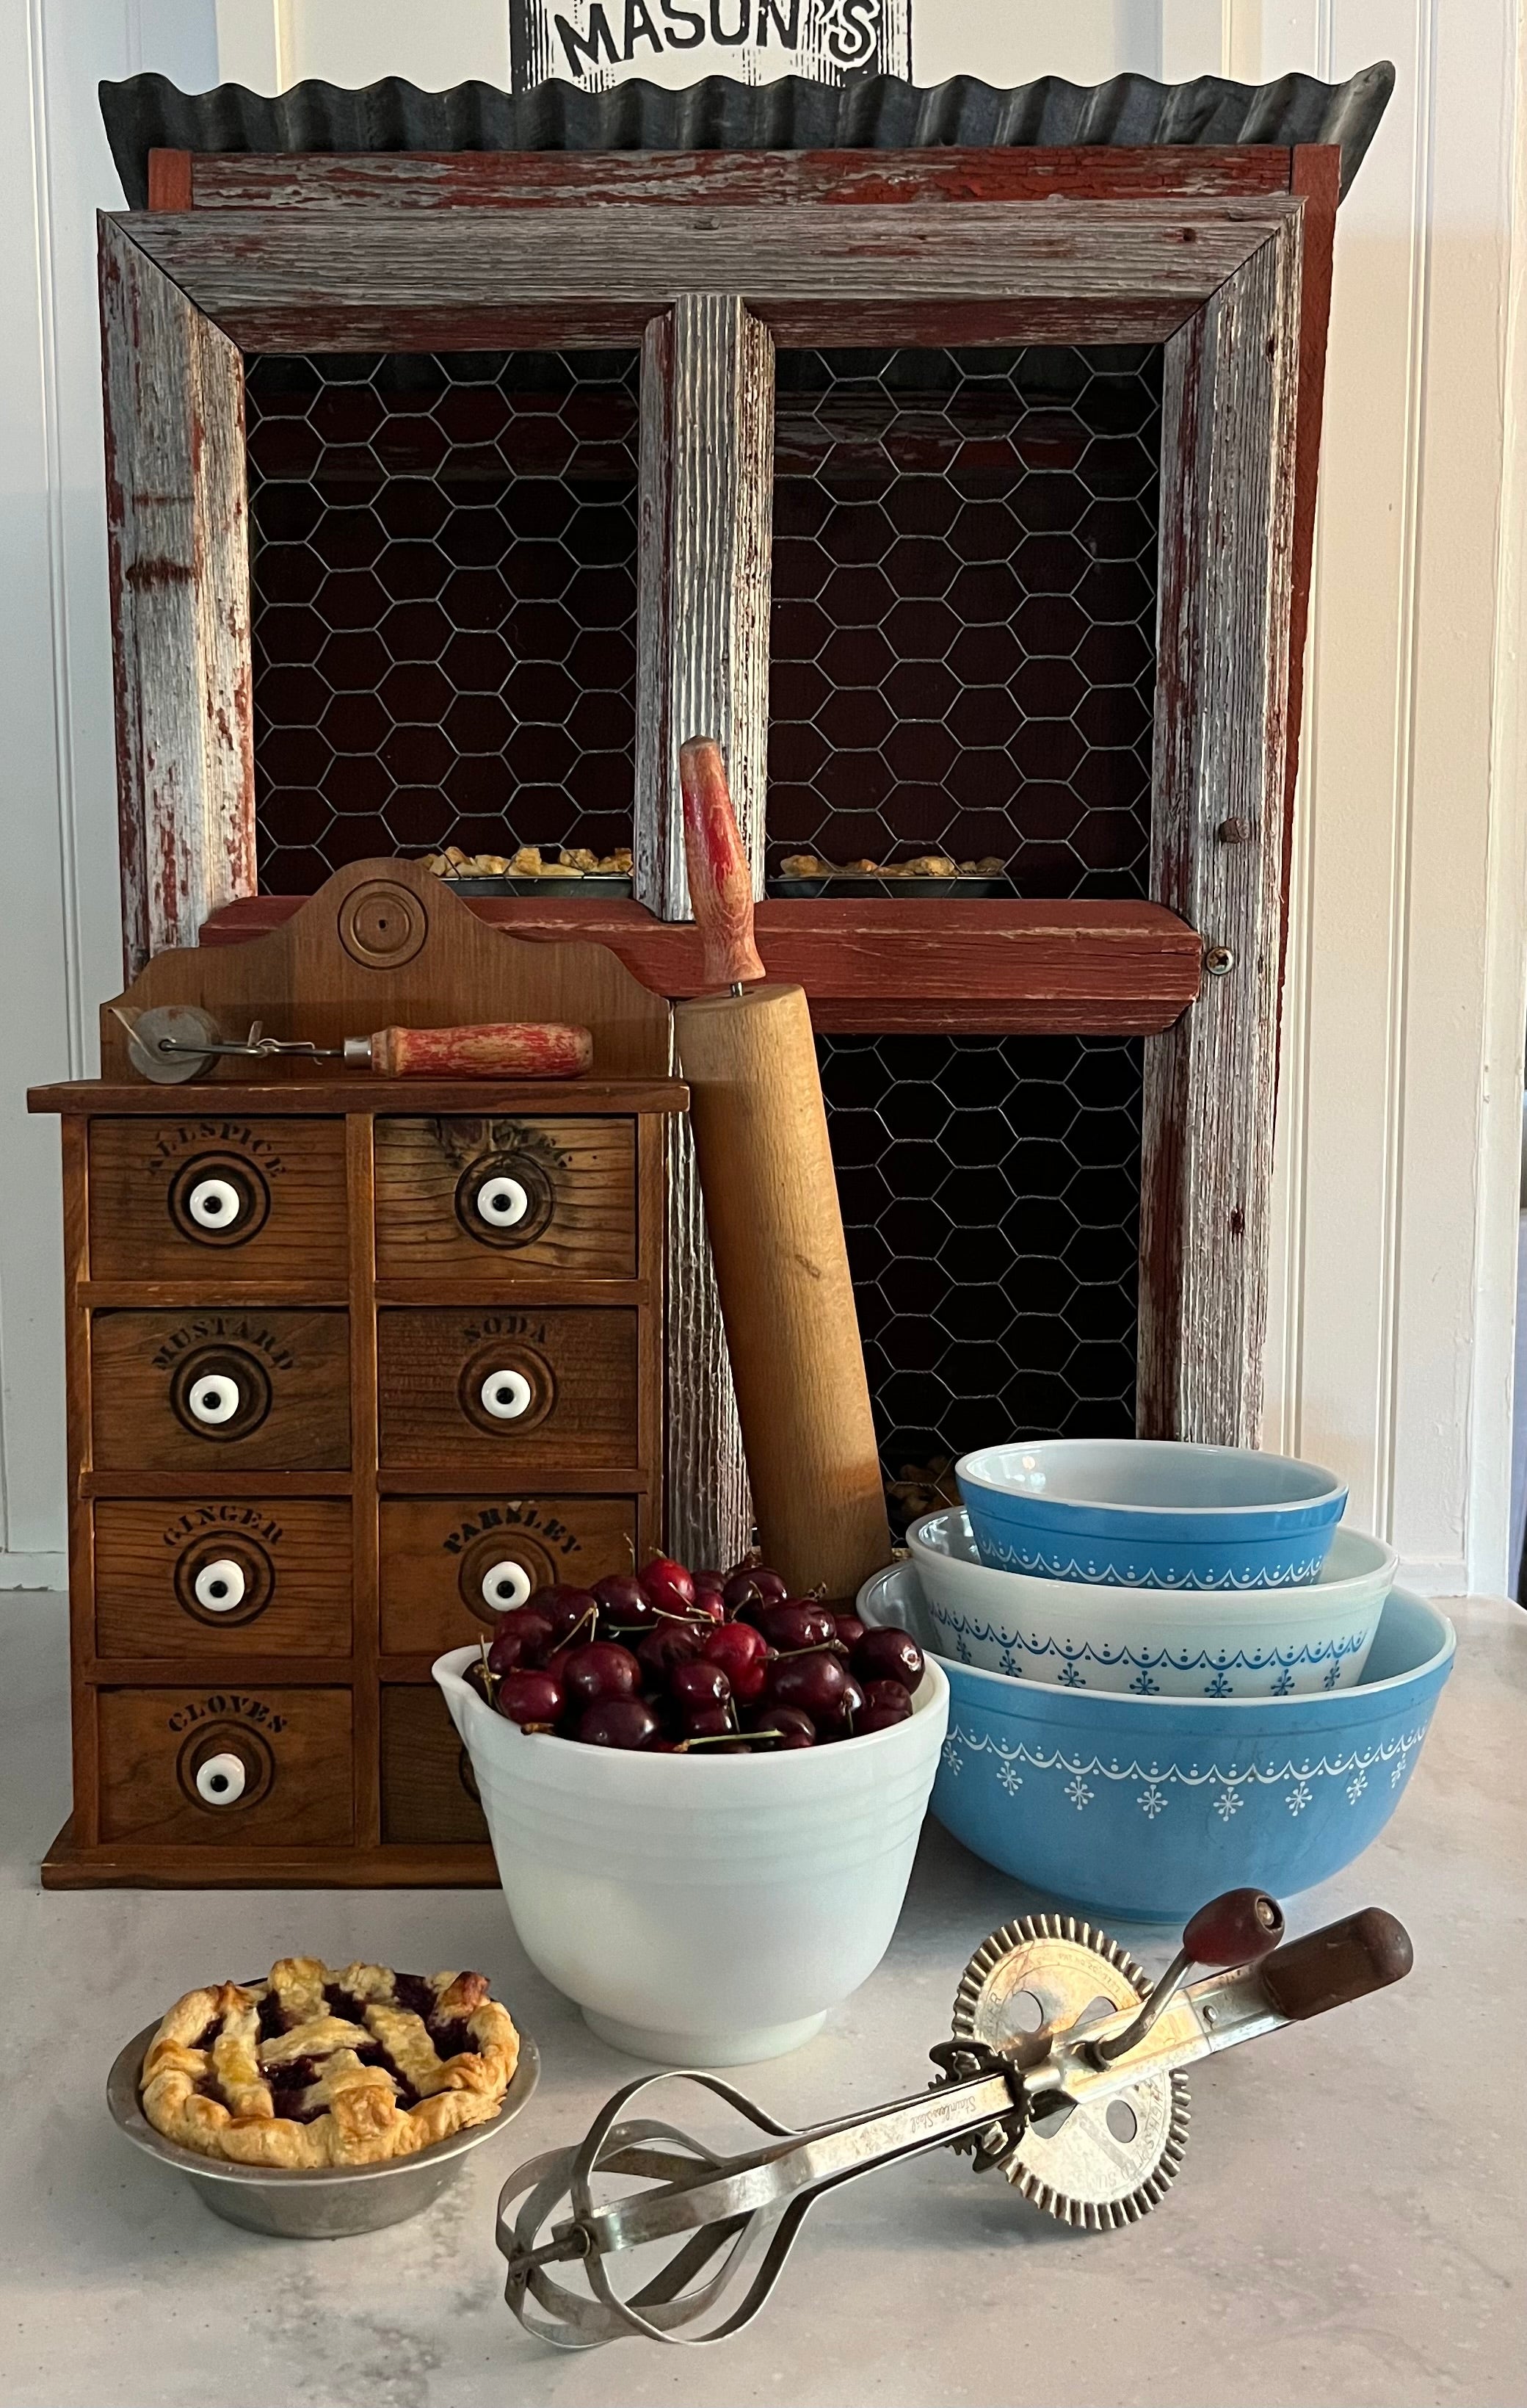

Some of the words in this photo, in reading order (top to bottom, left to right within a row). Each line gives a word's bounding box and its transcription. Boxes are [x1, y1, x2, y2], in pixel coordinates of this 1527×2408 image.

[151, 1317, 294, 1370] MUSTARD
[463, 1315, 545, 1344] SODA
[163, 1505, 283, 1546] GINGER
[168, 1695, 288, 1733] CLOVES
